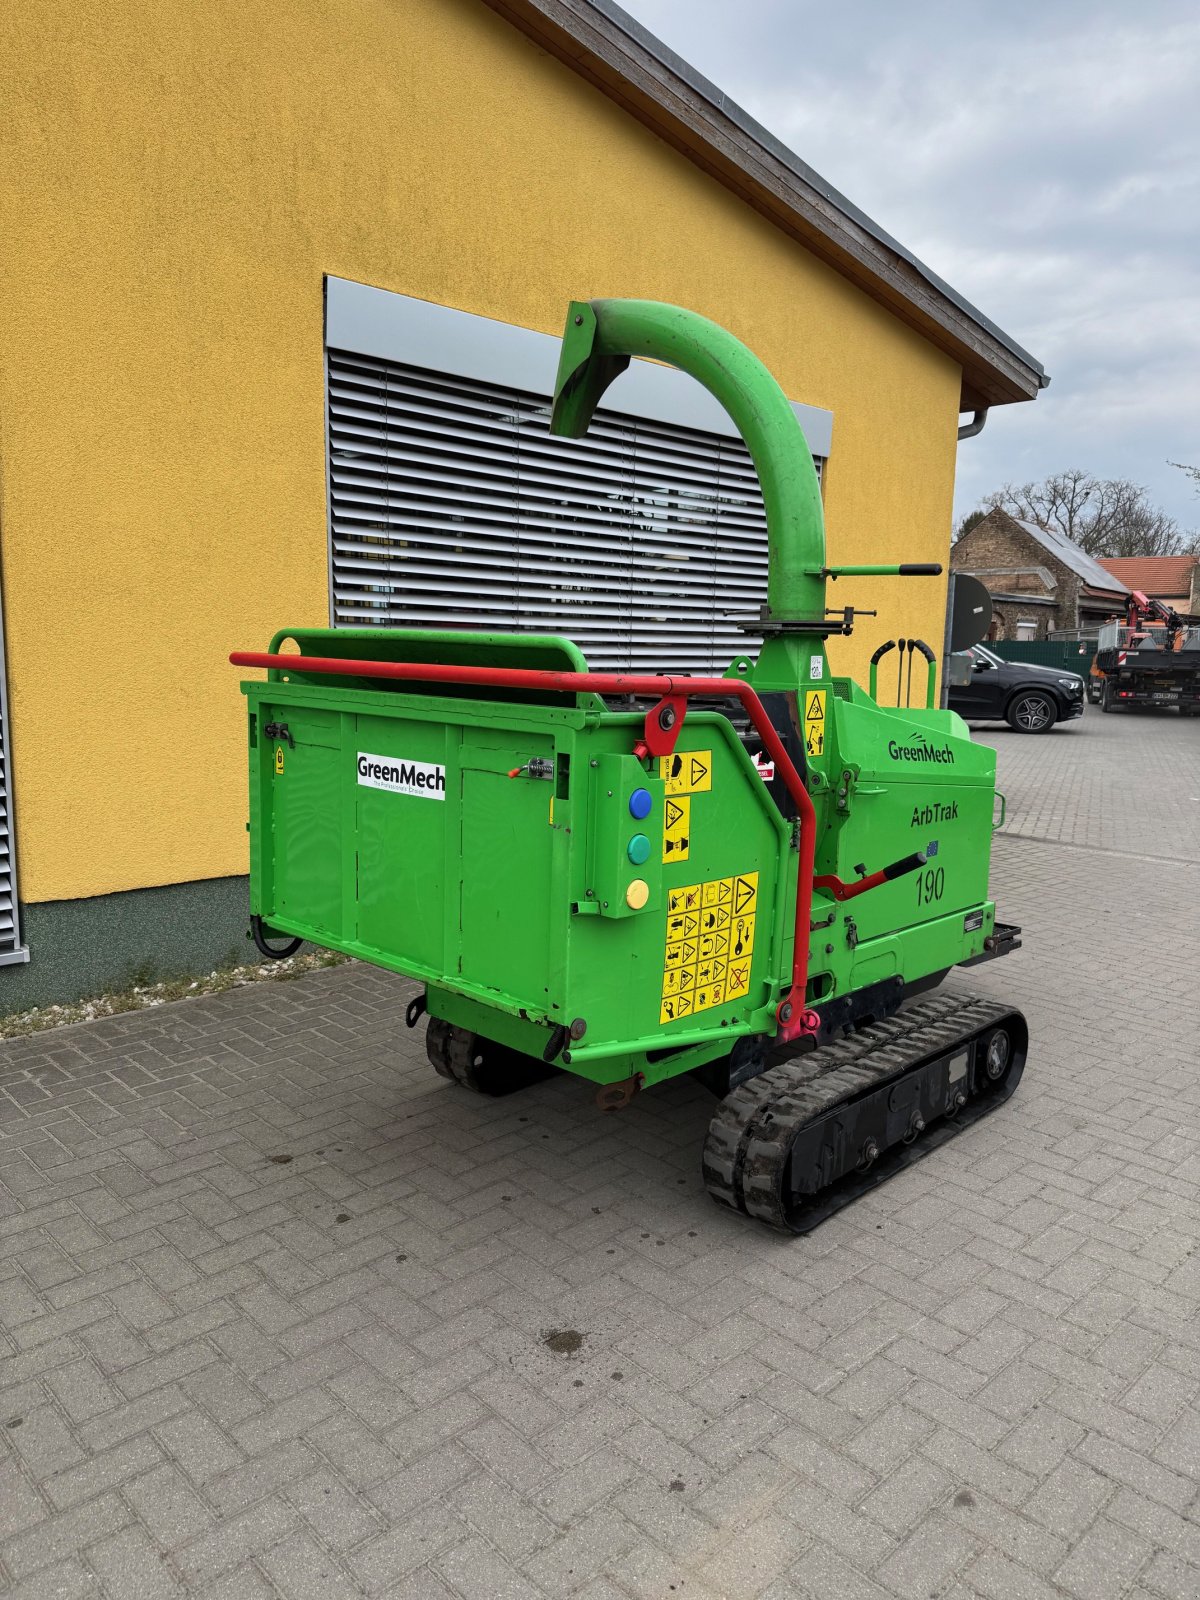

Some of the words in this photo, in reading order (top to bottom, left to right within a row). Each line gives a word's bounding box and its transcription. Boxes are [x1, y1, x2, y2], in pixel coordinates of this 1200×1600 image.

[888, 740, 955, 764] GreenMech
[357, 756, 446, 791] GreenMech
[910, 801, 959, 828] ArbTrak
[916, 866, 945, 907] 190
